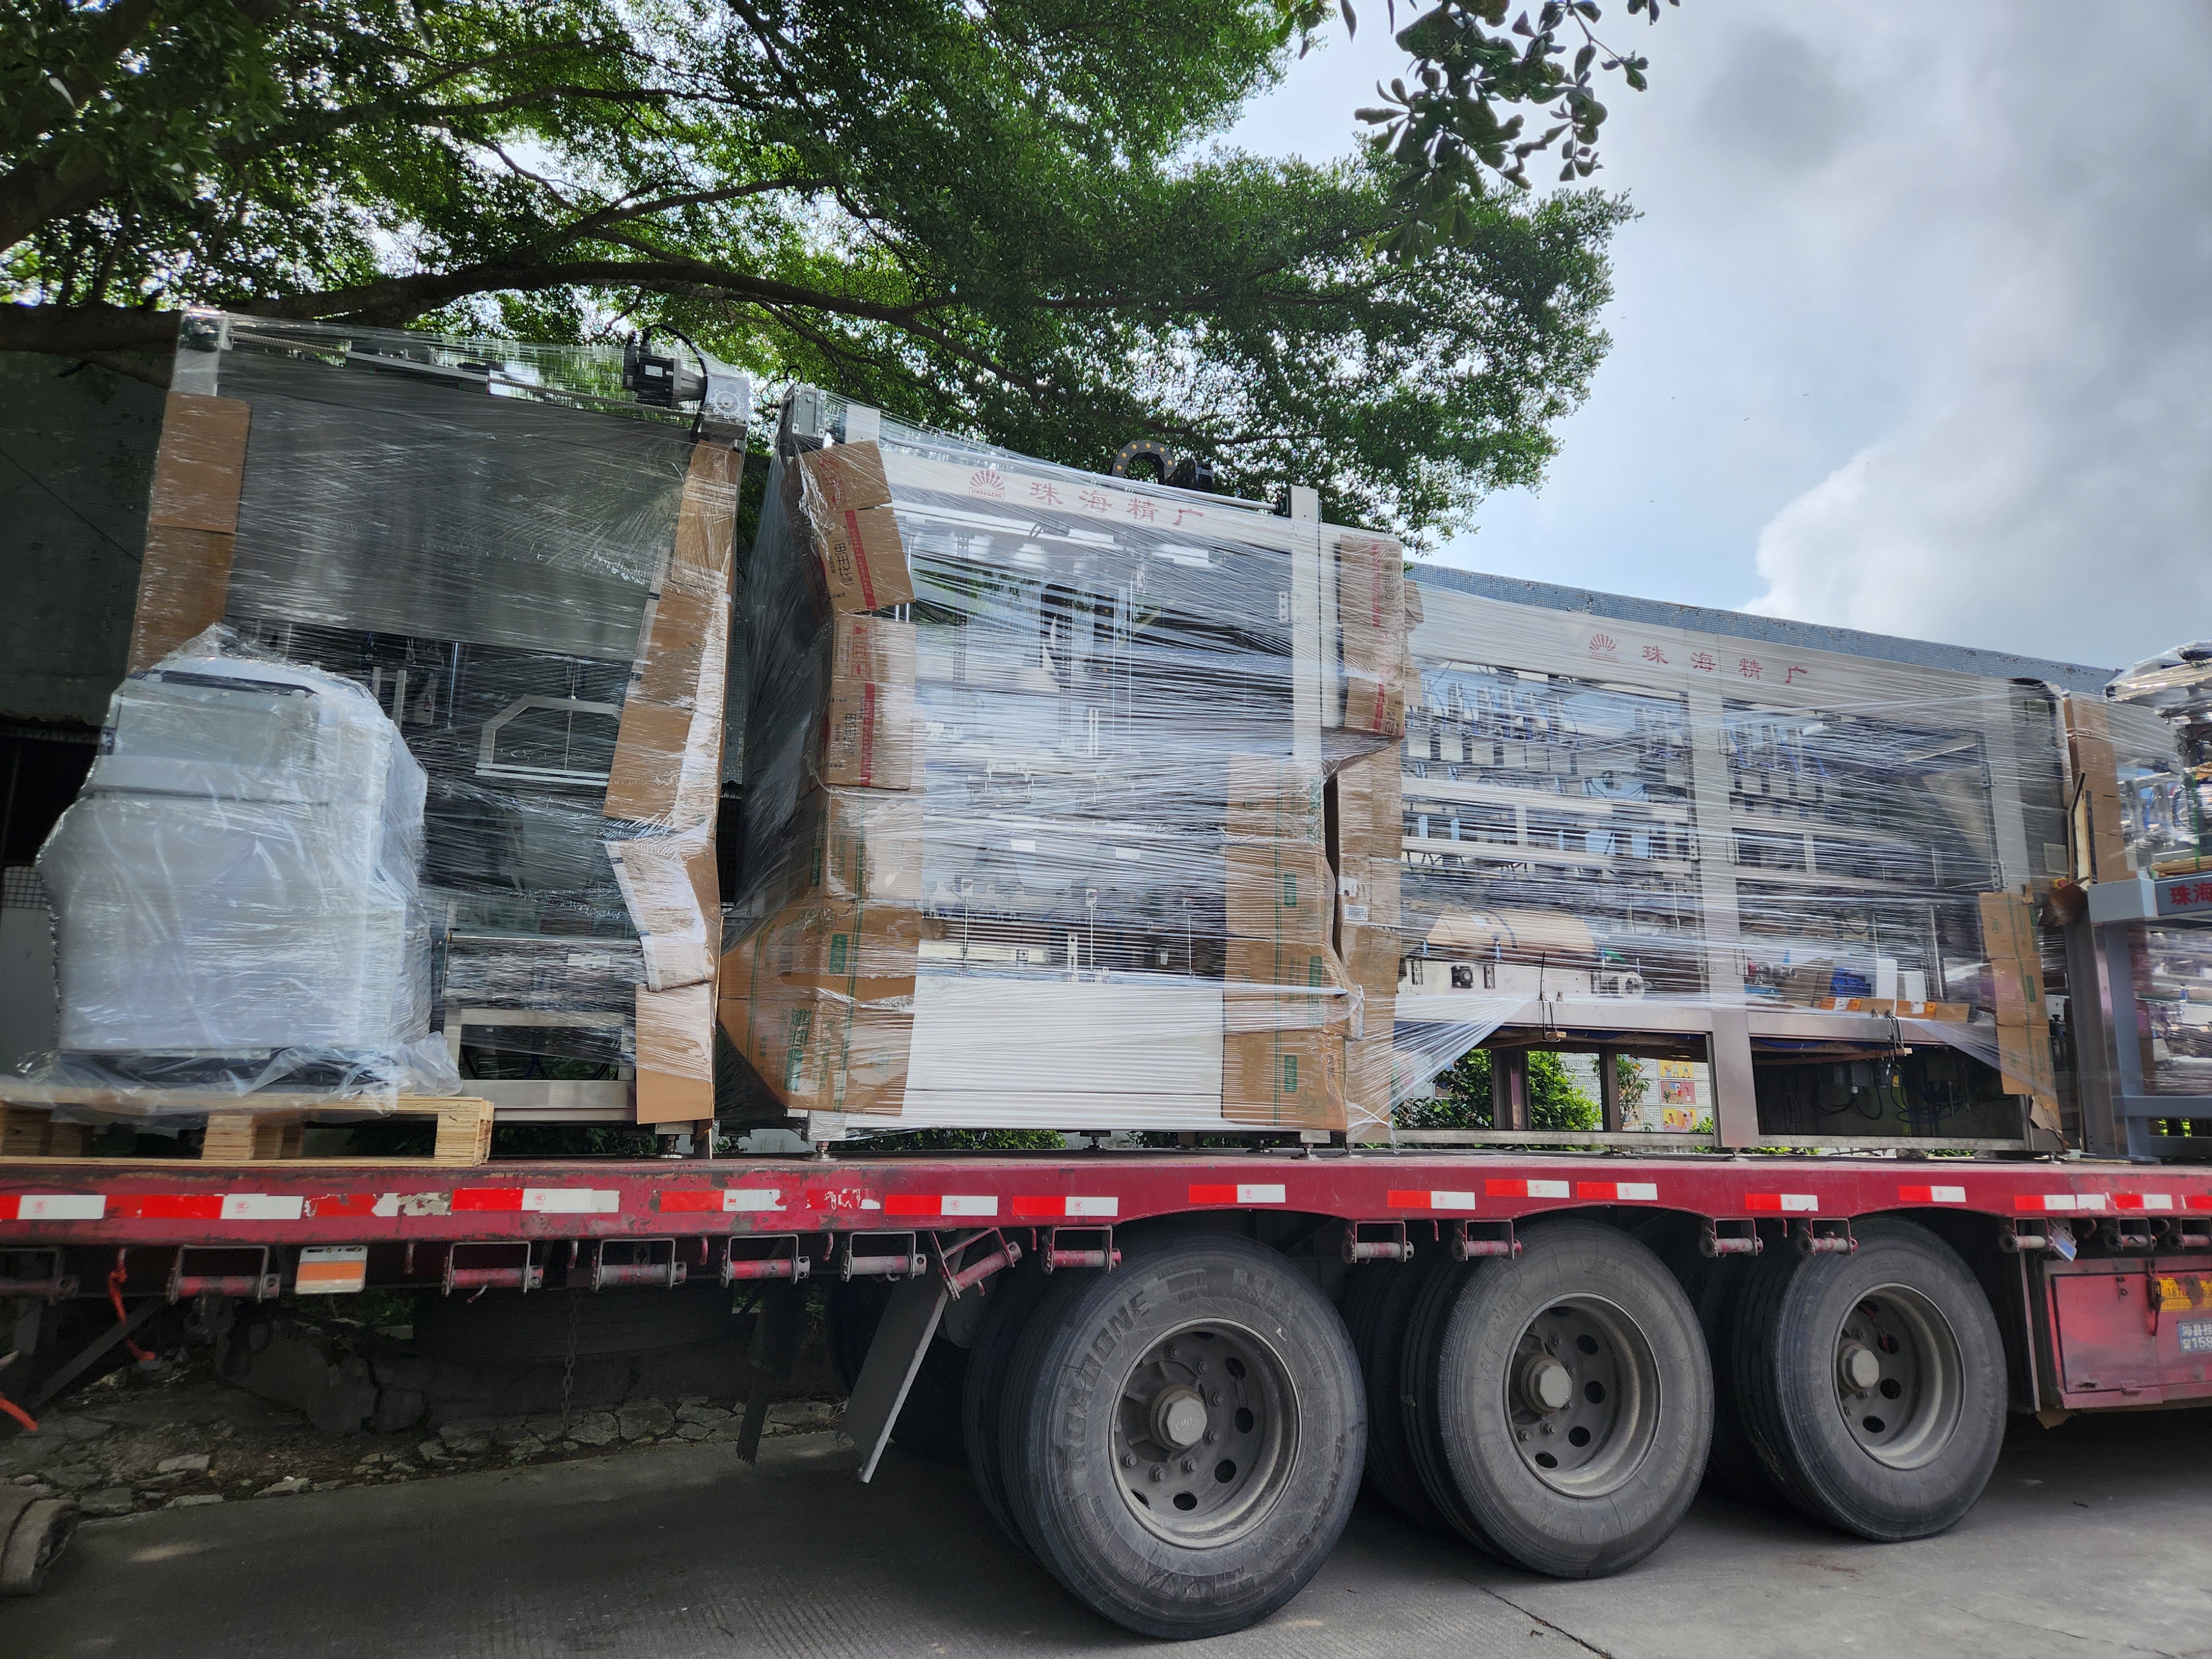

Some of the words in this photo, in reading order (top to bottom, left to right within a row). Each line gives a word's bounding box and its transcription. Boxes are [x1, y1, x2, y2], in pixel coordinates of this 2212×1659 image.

[1029, 482, 1204, 526] 珠海精广
[833, 542, 851, 577] 花生油
[1642, 645, 1808, 684] 珠海精广
[2169, 881, 2212, 906] 珠海
[2192, 1337, 2212, 1348] 158
[1060, 1291, 1149, 1472] ROADONE
